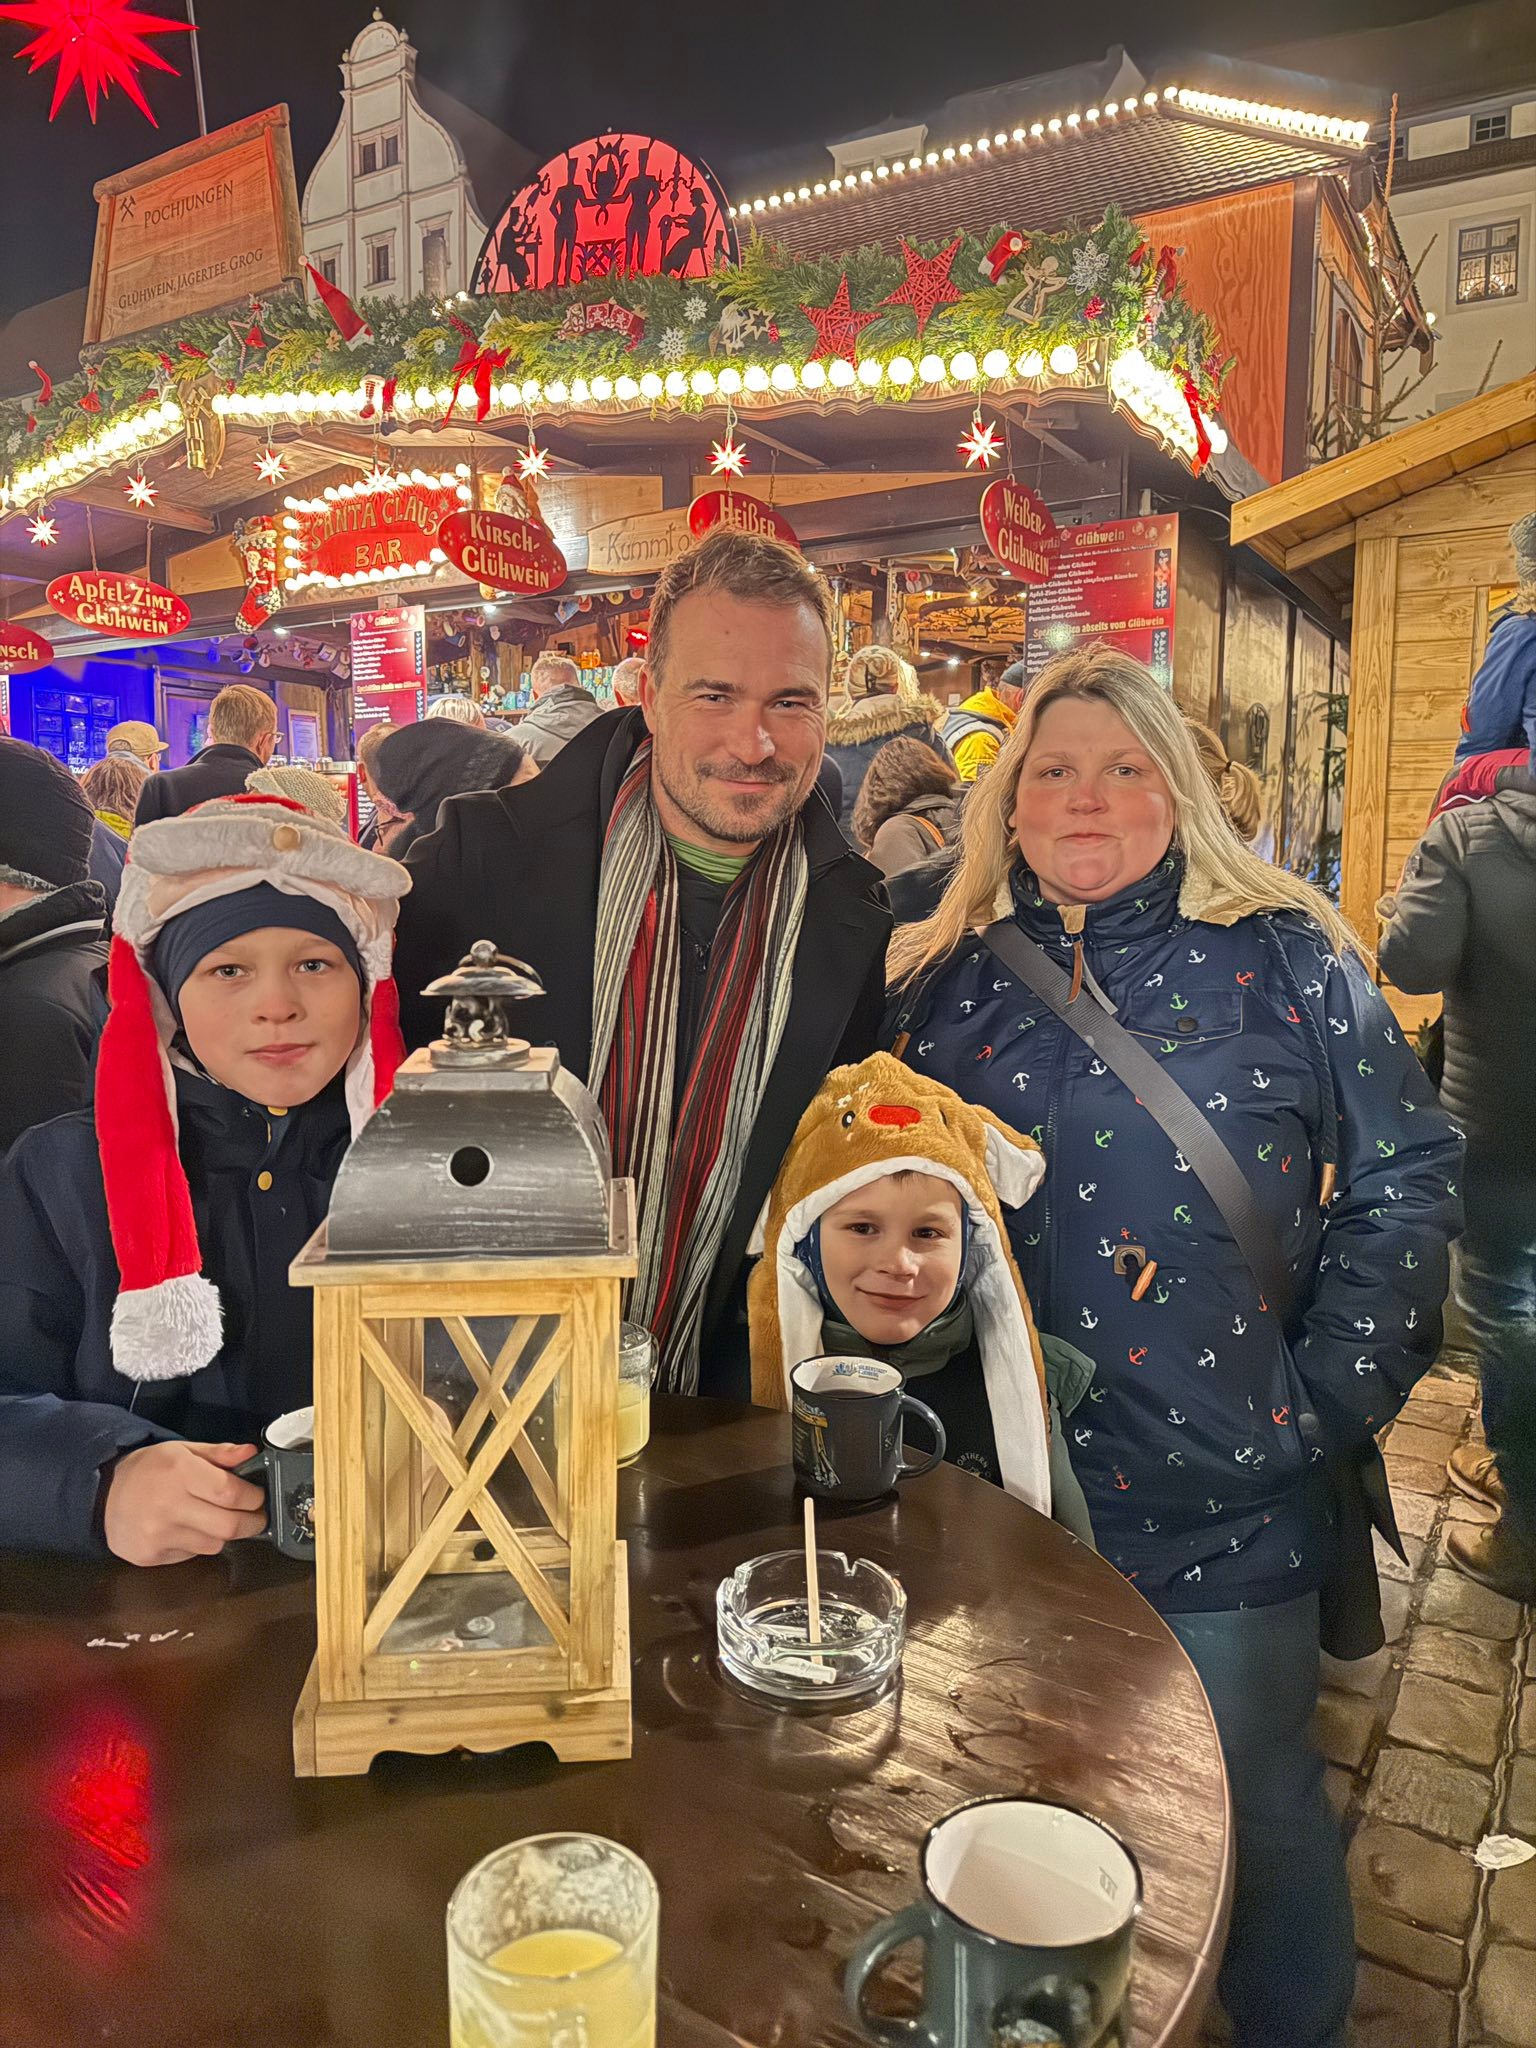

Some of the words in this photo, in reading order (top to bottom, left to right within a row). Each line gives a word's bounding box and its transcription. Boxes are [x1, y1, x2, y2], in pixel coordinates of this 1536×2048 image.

[144, 180, 234, 229] POCHJUNGEN
[229, 247, 264, 271] GROG
[310, 501, 377, 550] SANTA
[382, 495, 439, 537] CLAUS
[1075, 528, 1125, 547] Glühwein
[354, 538, 404, 569] BAR
[1110, 620, 1126, 630] vom
[957, 1452, 988, 1468] ORTHERN
